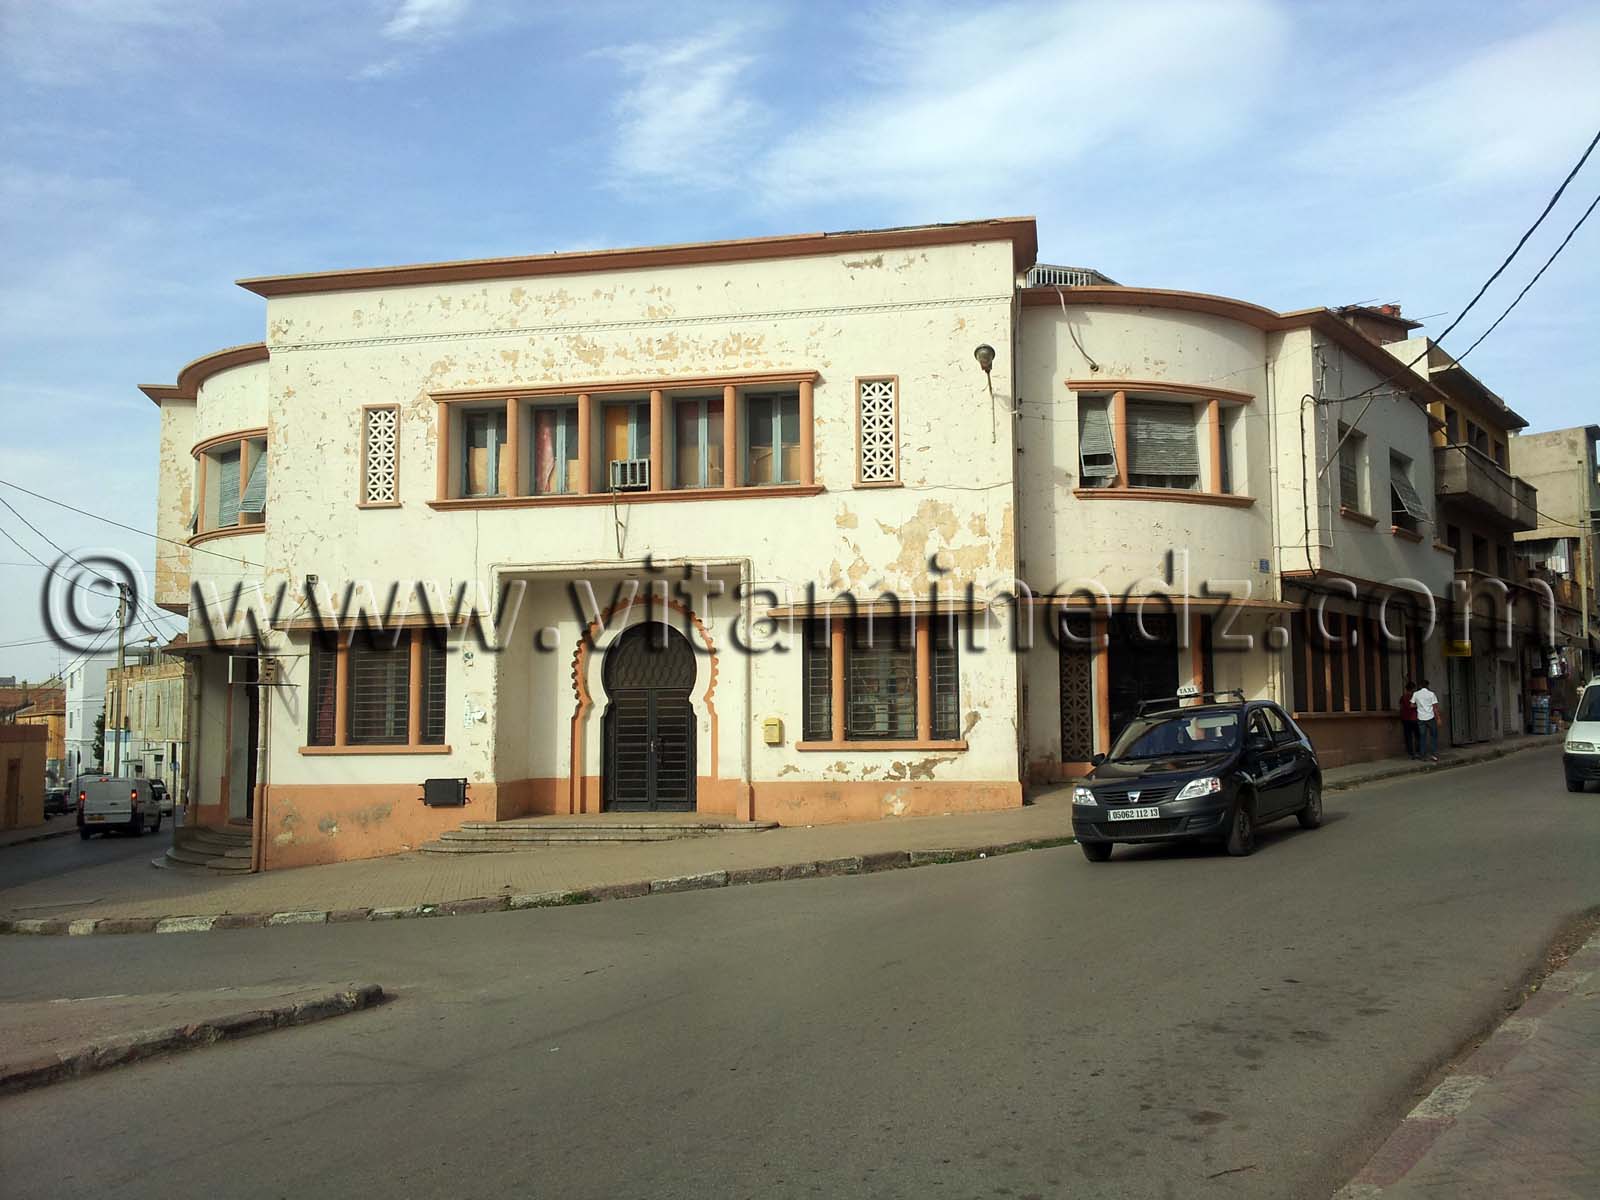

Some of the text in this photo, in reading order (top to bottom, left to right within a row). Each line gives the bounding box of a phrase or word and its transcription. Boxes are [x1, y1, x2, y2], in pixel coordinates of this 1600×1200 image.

[1112, 808, 1158, 820] 05062 112 13
